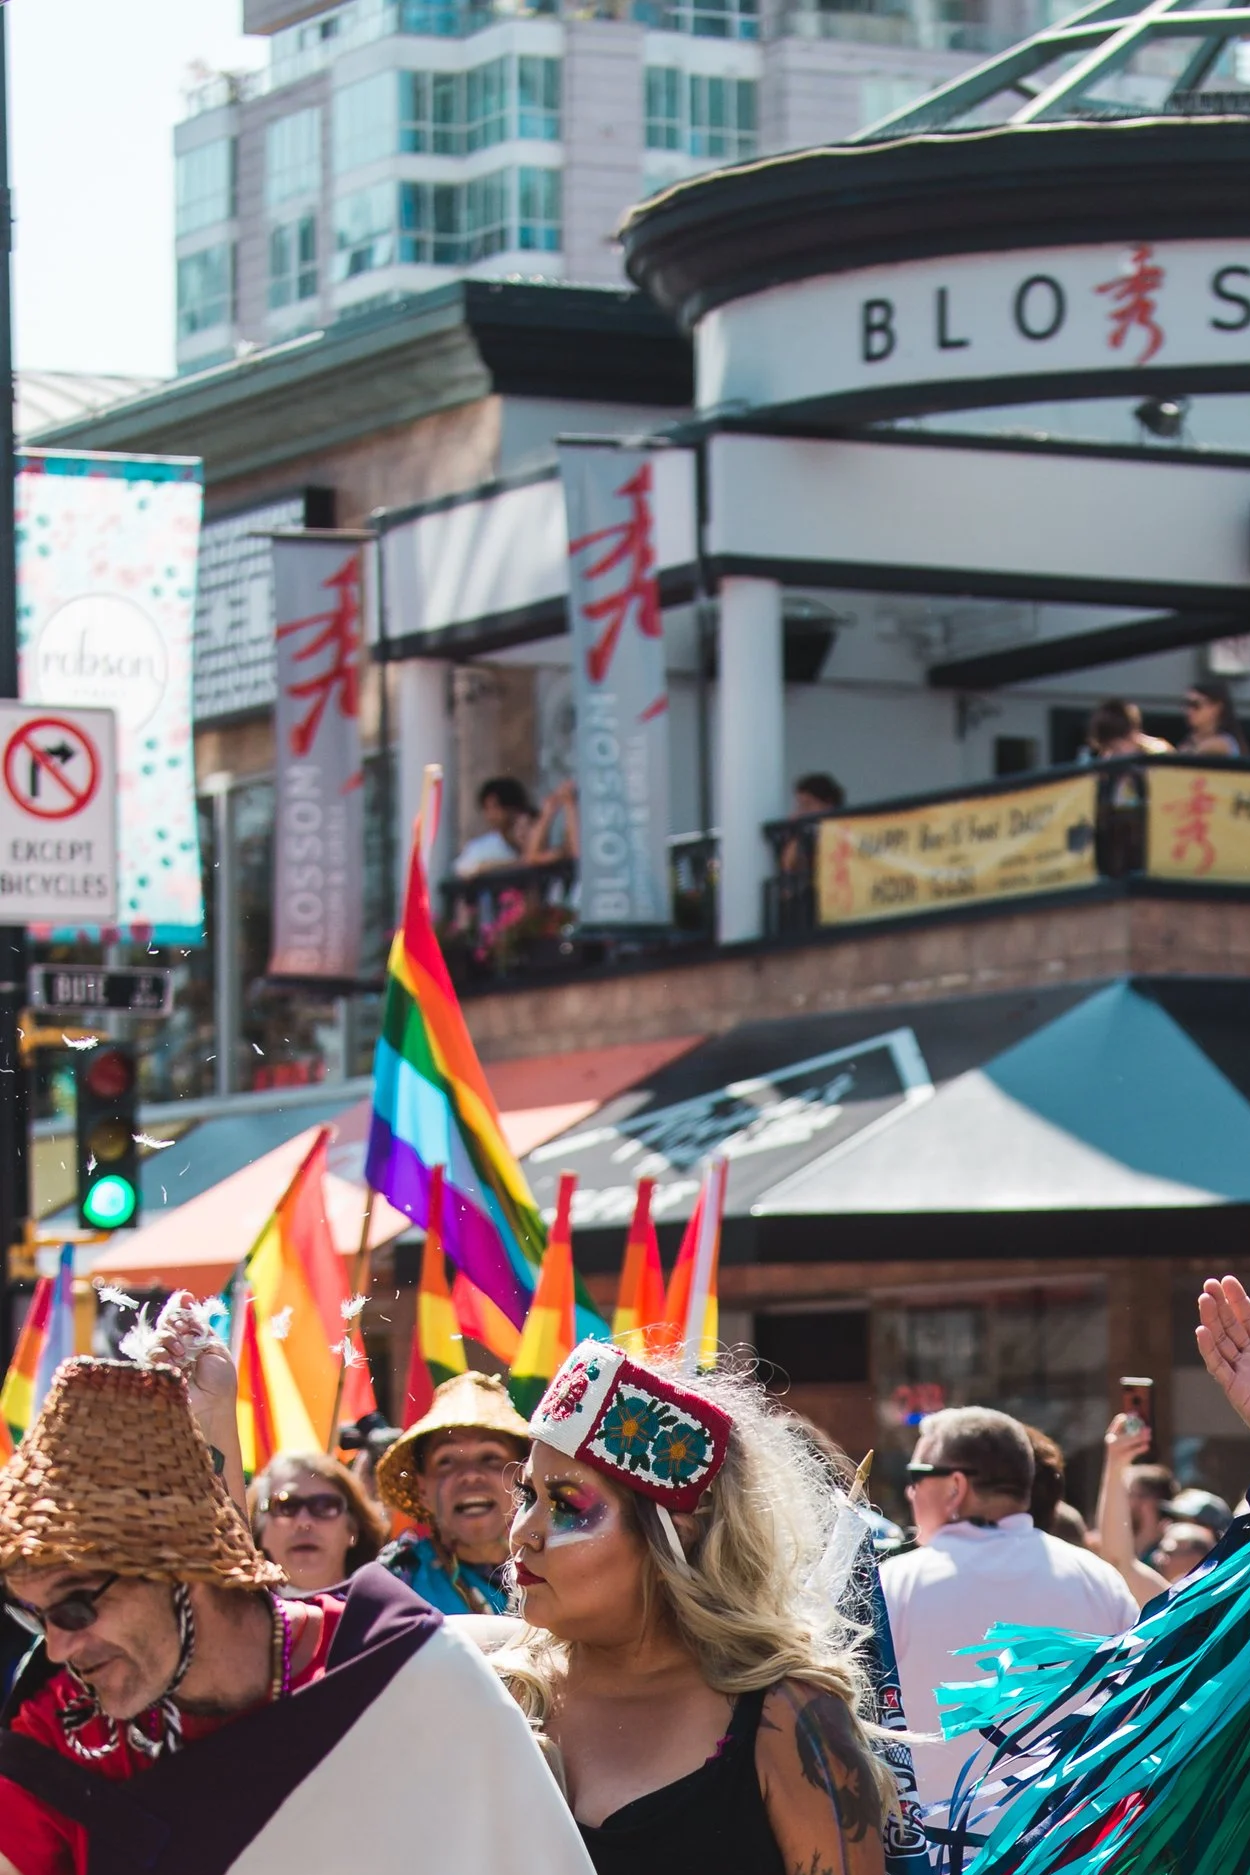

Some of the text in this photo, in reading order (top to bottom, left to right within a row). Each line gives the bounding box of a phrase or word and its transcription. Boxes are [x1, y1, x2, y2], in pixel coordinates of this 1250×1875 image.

[11, 838, 94, 863] EXCEPT
[0, 872, 108, 899] BICYCLES
[53, 972, 108, 1005] BUTE
